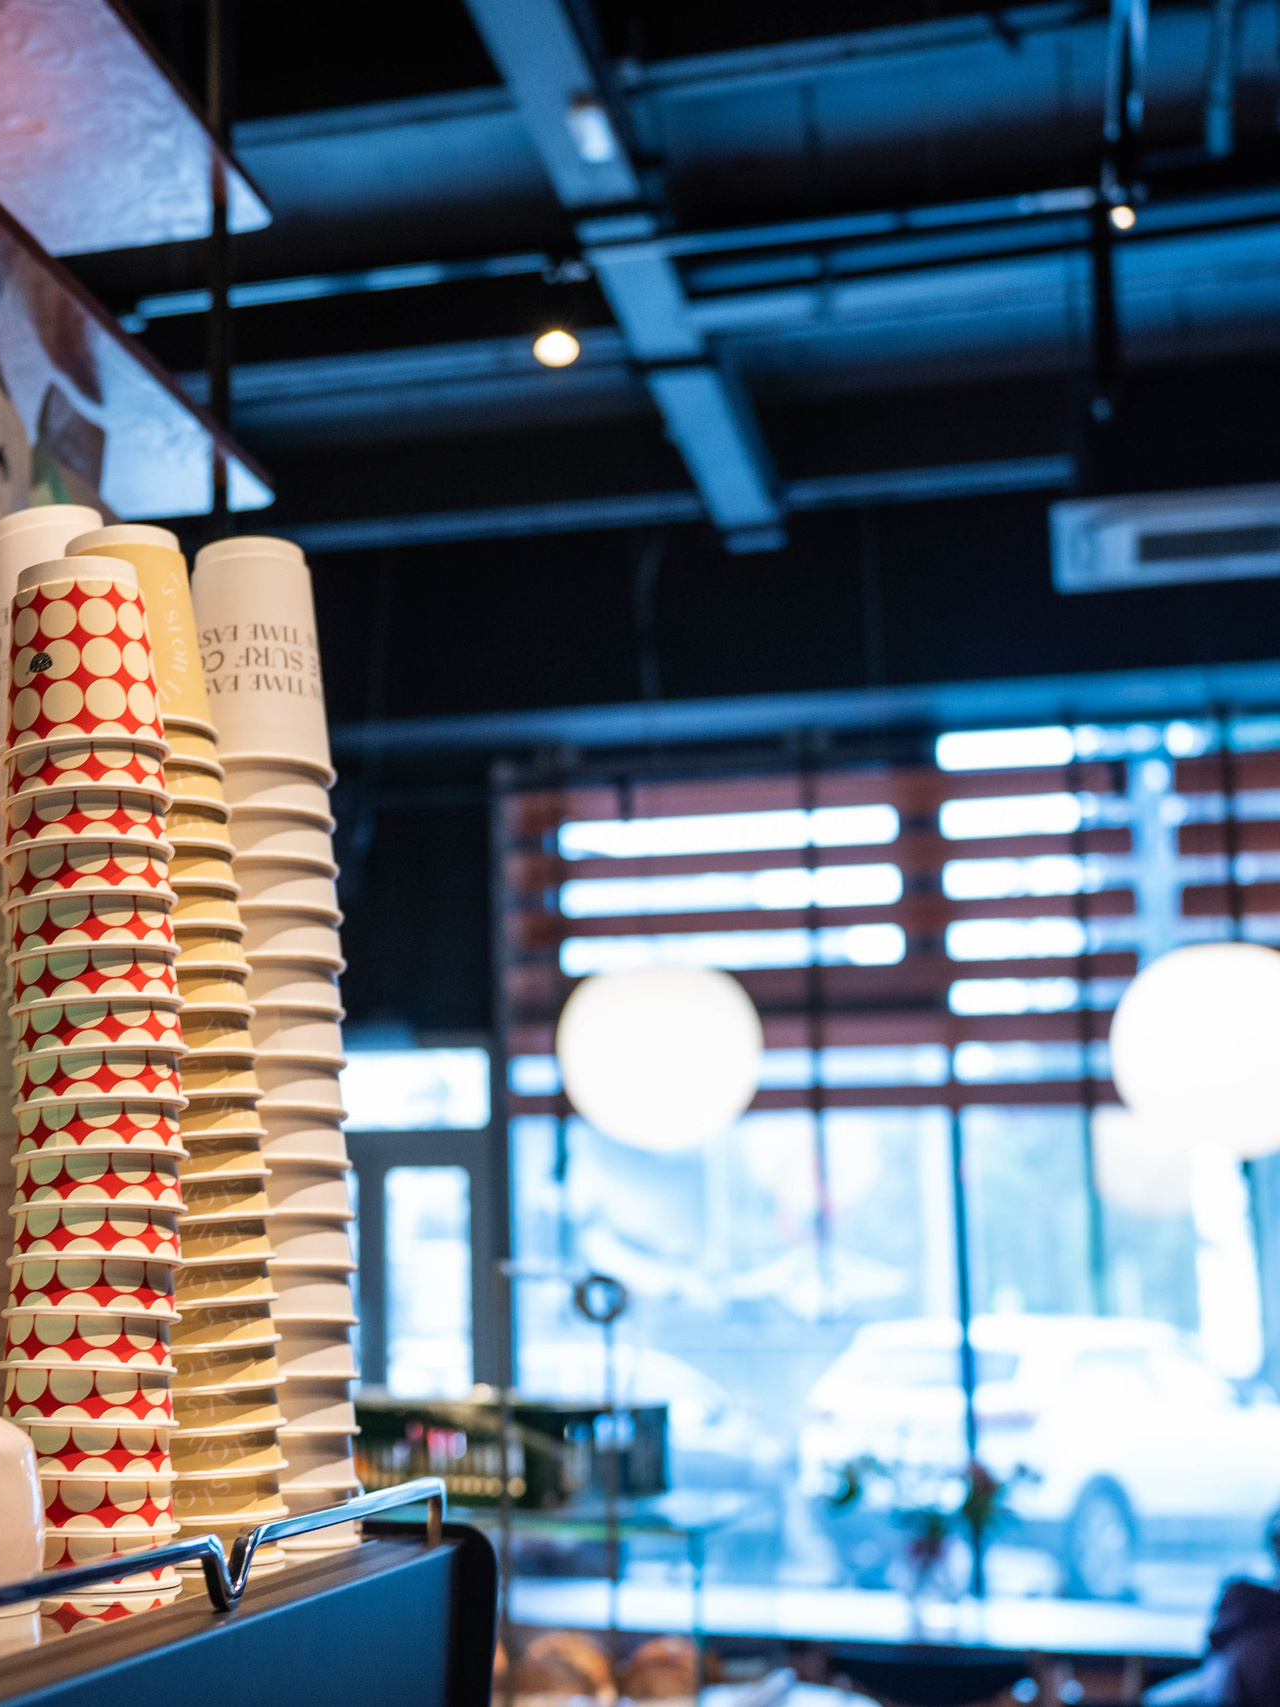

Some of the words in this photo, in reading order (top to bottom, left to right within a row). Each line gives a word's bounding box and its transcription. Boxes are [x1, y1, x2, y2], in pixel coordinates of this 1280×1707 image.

[196, 624, 238, 648] EAS
[246, 623, 301, 647] TIME
[234, 646, 303, 672] SURF
[247, 673, 307, 698] TIME
[173, 1479, 230, 1509] SLO
